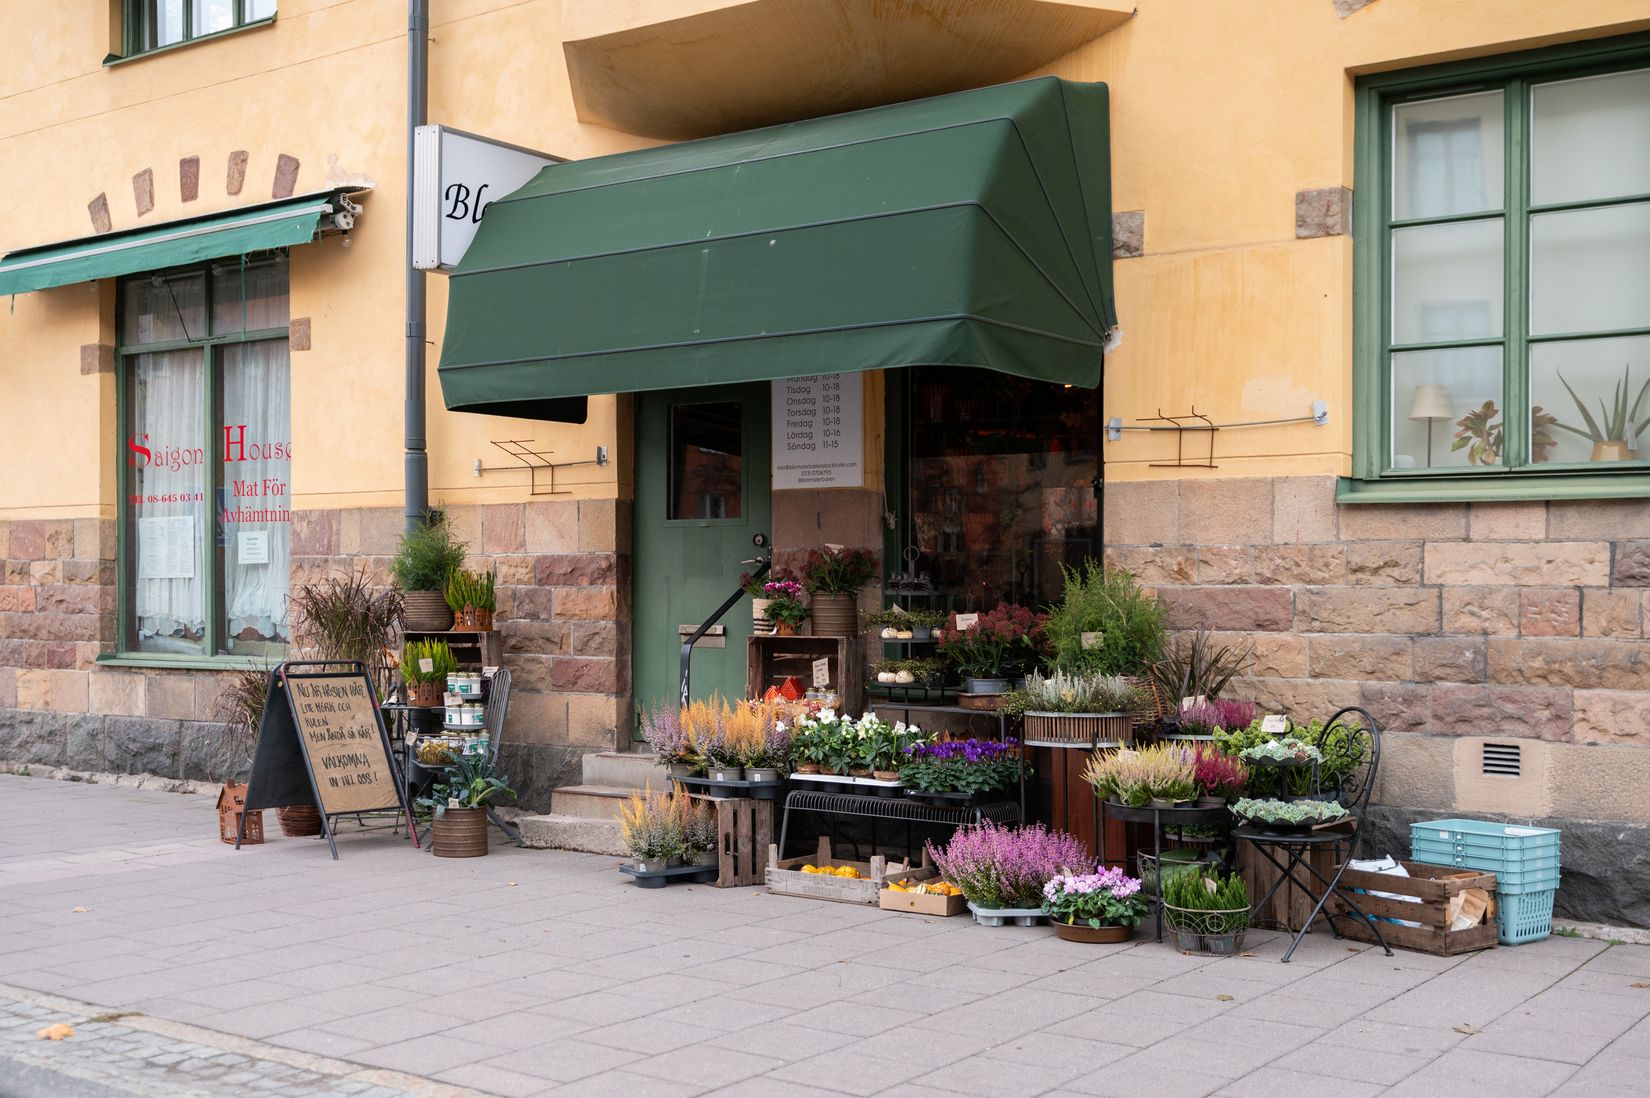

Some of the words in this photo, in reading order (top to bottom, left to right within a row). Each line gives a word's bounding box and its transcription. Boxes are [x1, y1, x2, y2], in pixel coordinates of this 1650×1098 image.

[786, 386, 811, 394] Tisdag
[822, 383, 840, 391] 10-18
[786, 397, 816, 405] Onsdag
[822, 394, 840, 403] 10-18
[786, 408, 816, 417] Torsdag
[822, 406, 840, 414] 10-18
[786, 420, 813, 428] Fredag
[822, 417, 840, 426] 10-18
[786, 431, 813, 440] Lördag
[822, 429, 840, 437] 10-16
[786, 443, 816, 451] Söndag
[822, 440, 839, 448] 11-15
[128, 433, 203, 472] Saigon
[233, 480, 258, 497] Mat
[263, 478, 286, 497] För
[147, 493, 178, 503] 08-645
[179, 491, 191, 502] 03
[193, 491, 203, 502] 41
[296, 683, 310, 698] NU
[338, 703, 351, 712] OCH
[309, 730, 326, 743] MEN
[329, 776, 339, 788] IN
[342, 774, 356, 787] TILL
